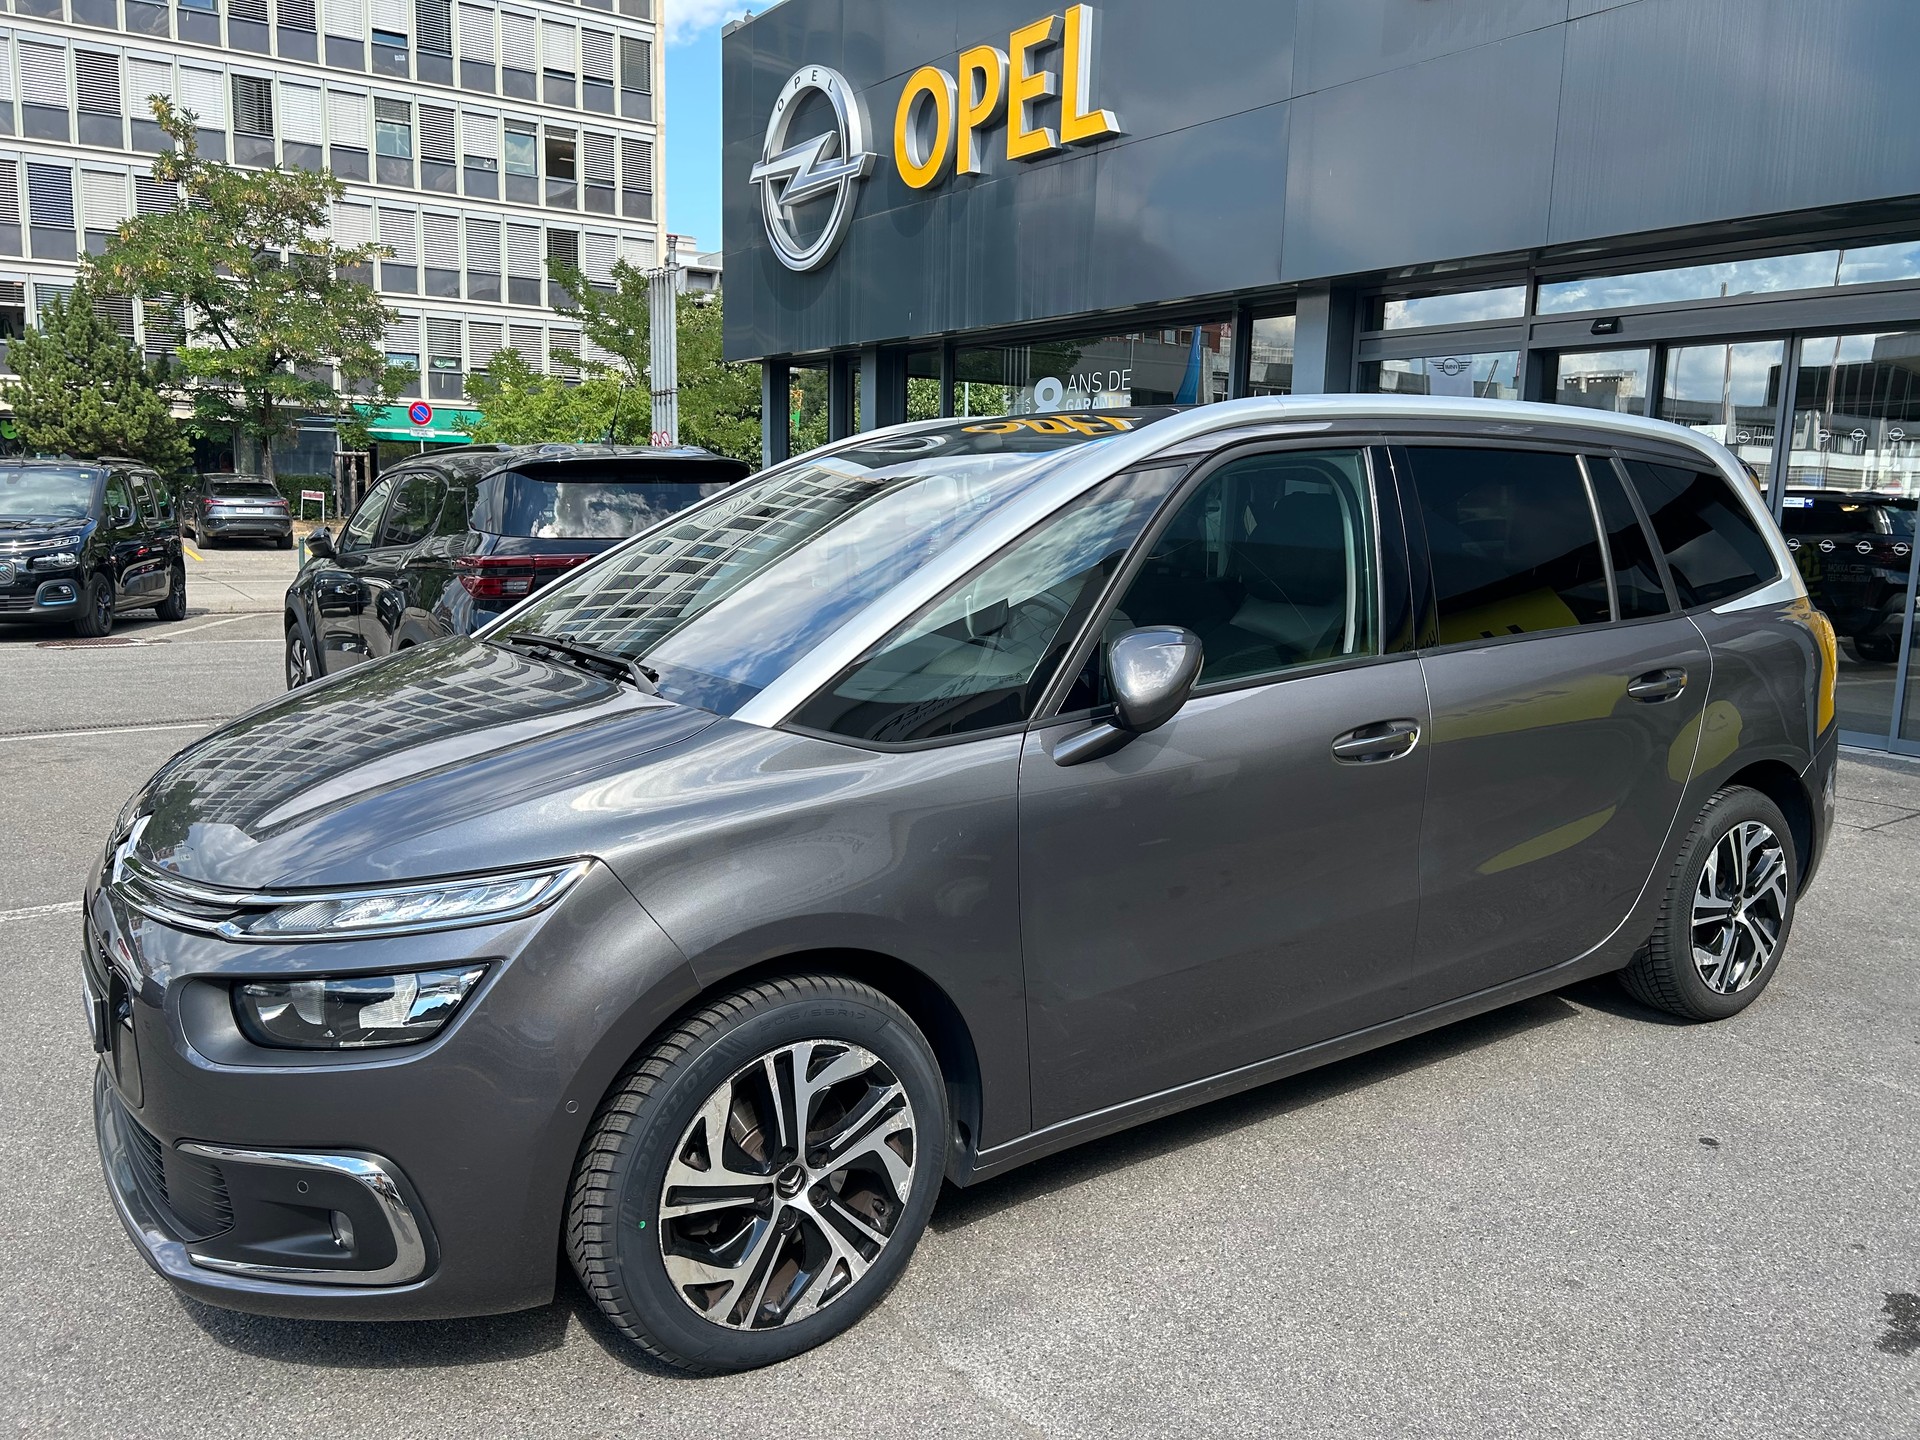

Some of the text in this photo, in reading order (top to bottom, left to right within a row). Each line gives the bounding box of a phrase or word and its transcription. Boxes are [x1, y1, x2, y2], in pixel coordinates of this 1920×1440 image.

[777, 70, 834, 112] OPEL
[894, 3, 1120, 190] OPEL
[1034, 376, 1063, 413] 8
[1066, 368, 1132, 395] ANS DE
[635, 1055, 715, 1173] DUNLOP
